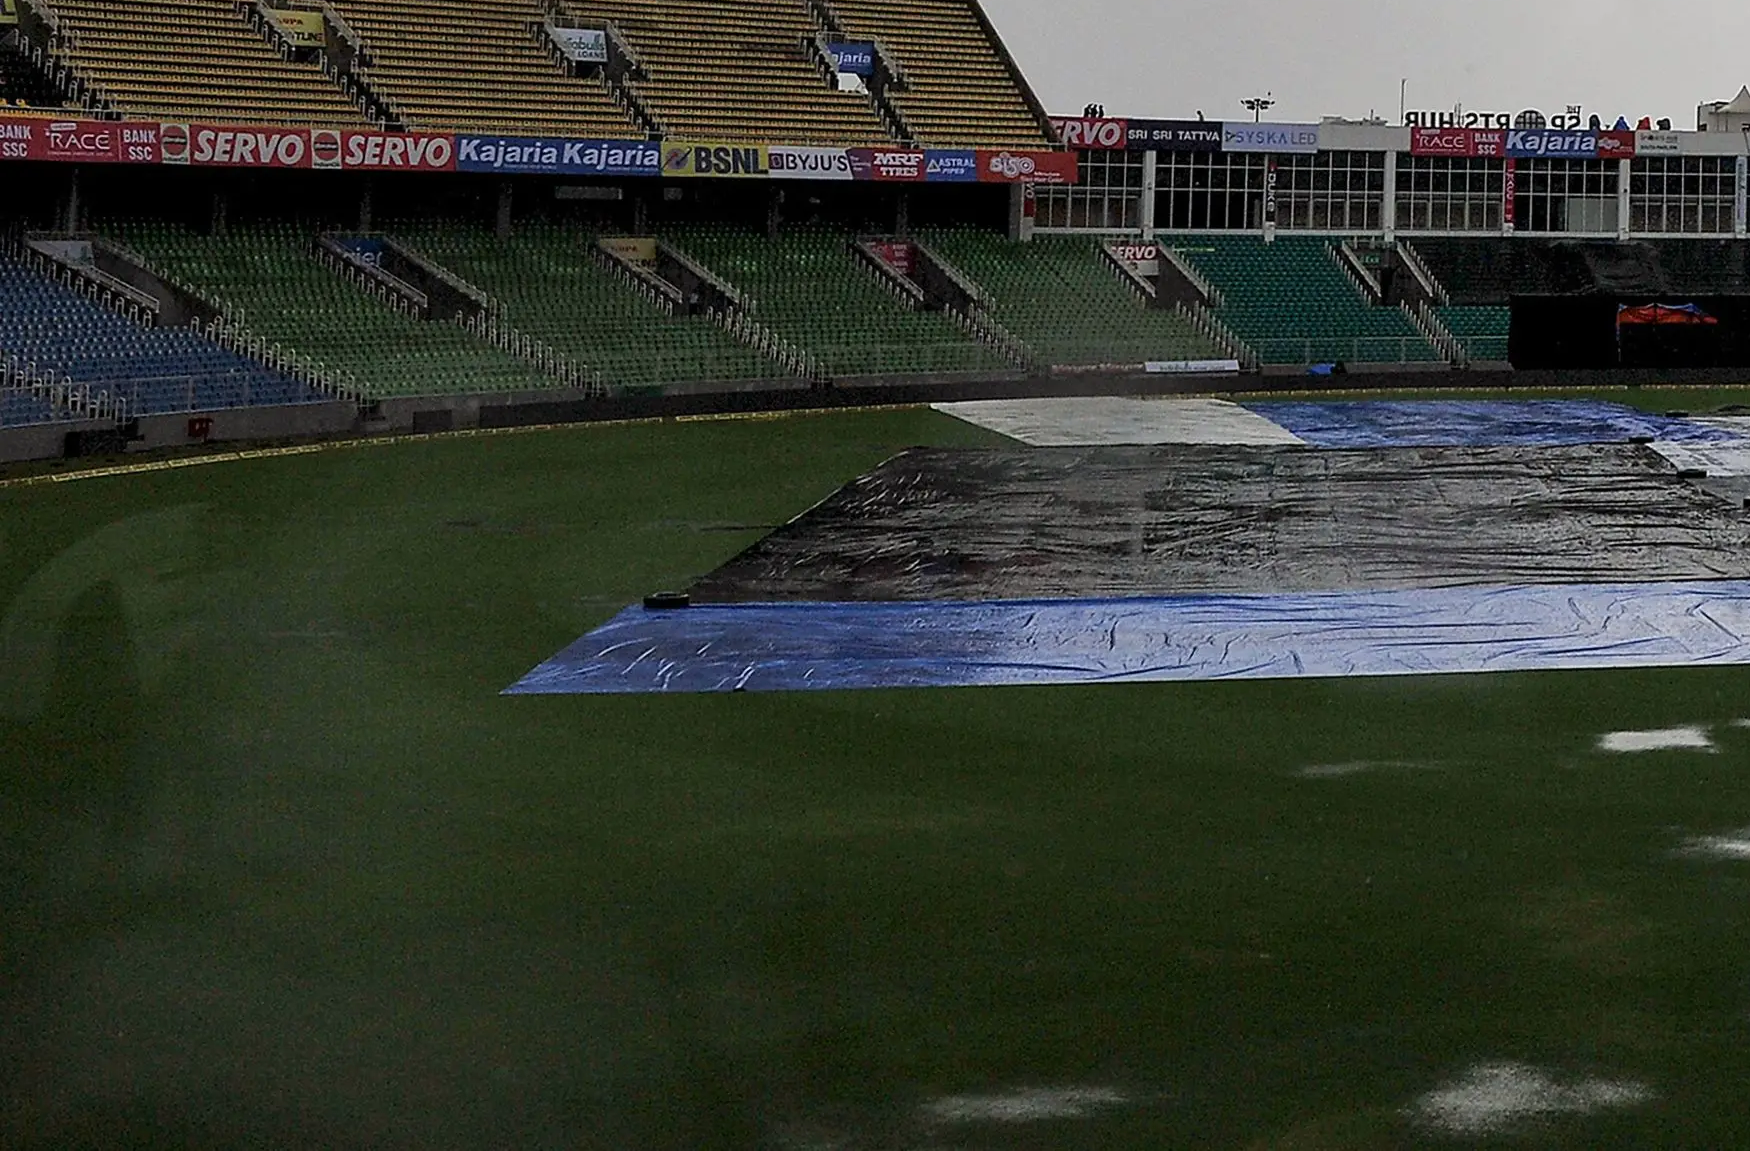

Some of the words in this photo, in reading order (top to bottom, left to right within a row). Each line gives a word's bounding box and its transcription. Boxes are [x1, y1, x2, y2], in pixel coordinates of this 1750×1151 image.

[123, 129, 157, 144] BANK
[1051, 120, 1122, 146] ERVO
[1128, 129, 1148, 140] SRI
[1152, 129, 1173, 141] SRI
[1176, 130, 1221, 142] TATTVA
[1235, 131, 1288, 145] SYSKA
[1290, 132, 1317, 146] LED
[2, 142, 28, 157] SSC
[193, 129, 305, 165] SERVO
[1477, 144, 1497, 155] SSC
[1506, 131, 1597, 155] Kajaria
[128, 146, 153, 161] SSC
[345, 134, 452, 168] SERVO
[460, 138, 558, 168] Kajaria
[562, 143, 660, 170] Kajaria
[873, 152, 924, 165] MRF
[694, 147, 769, 174] BSNL
[786, 154, 848, 171] BYJU'S
[938, 157, 976, 167] ASTRAL
